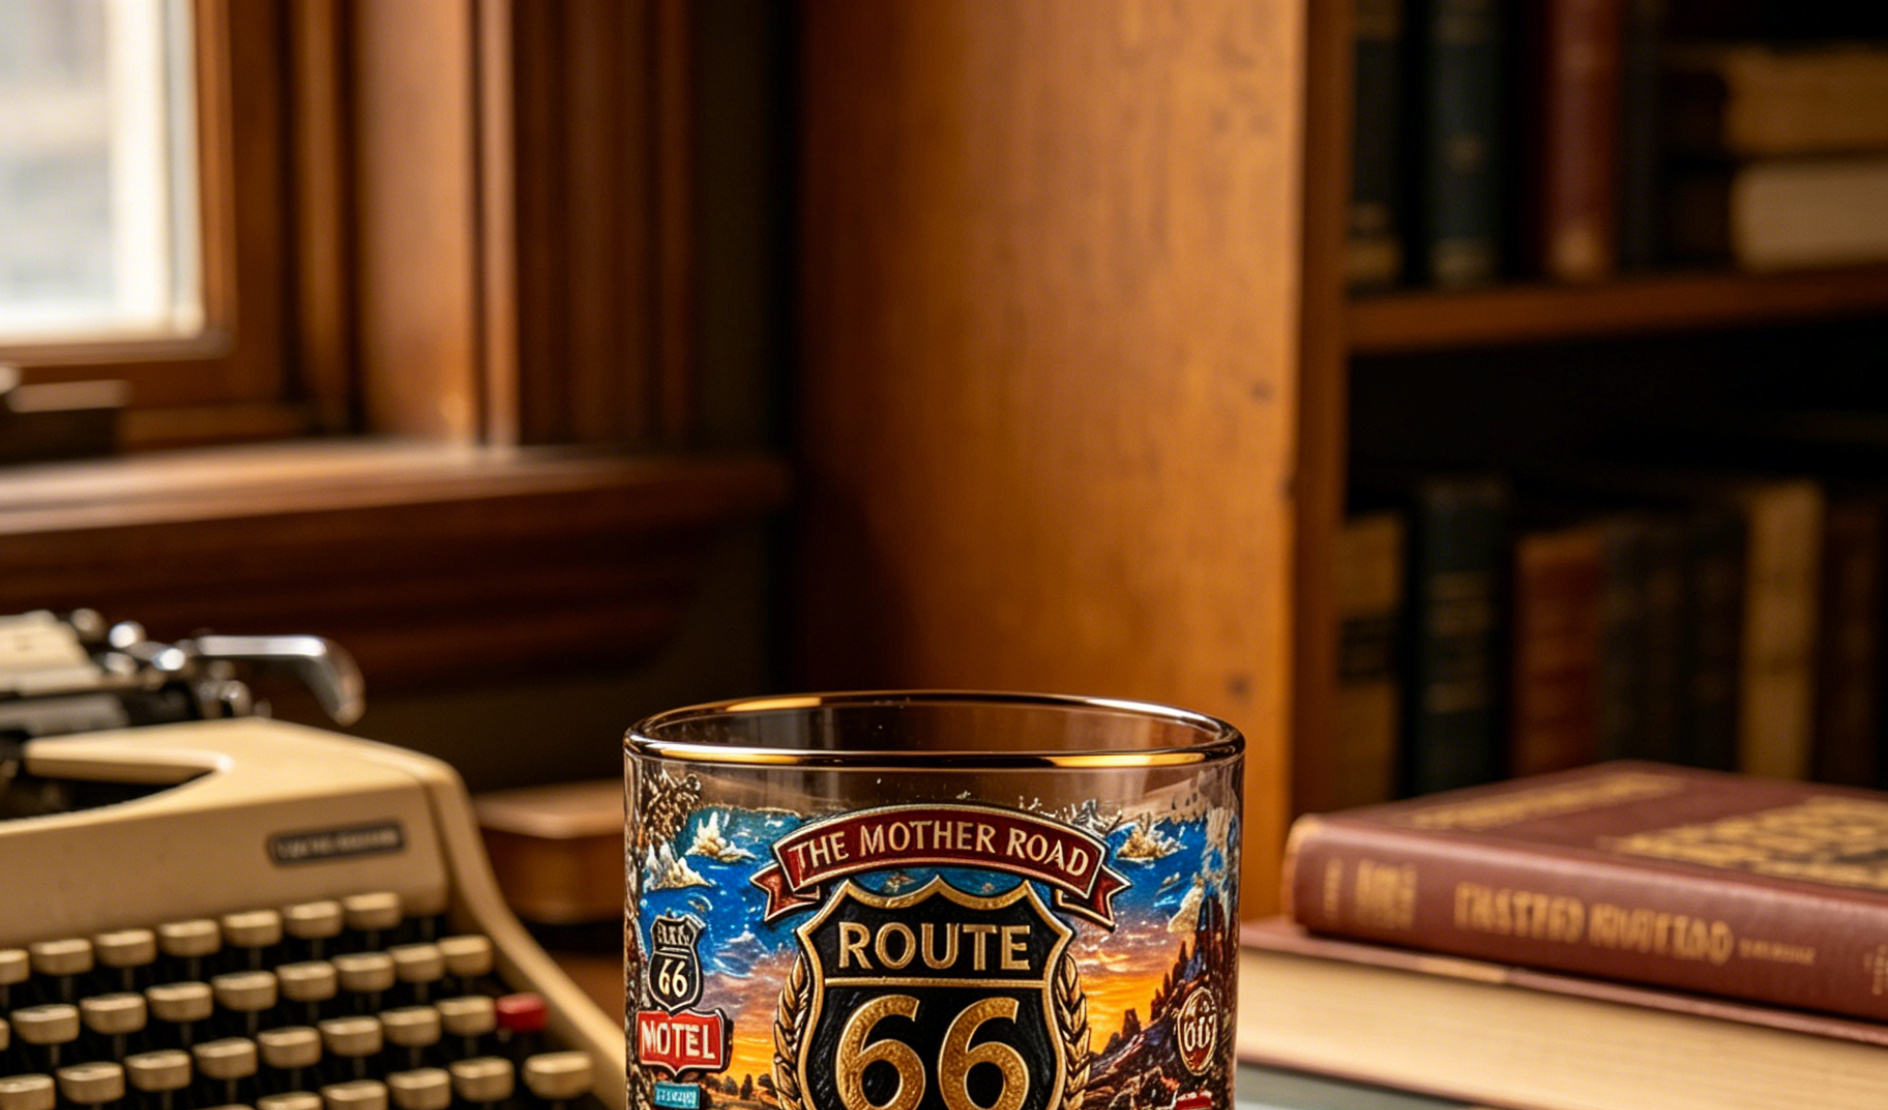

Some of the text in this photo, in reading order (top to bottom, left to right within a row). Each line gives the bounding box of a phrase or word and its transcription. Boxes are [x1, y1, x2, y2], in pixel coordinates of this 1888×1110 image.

[787, 820, 1089, 877] THE MOTHER ROAD
[838, 921, 1030, 971] ROUTE
[658, 958, 688, 998] 66
[641, 1020, 716, 1059] MOTEL
